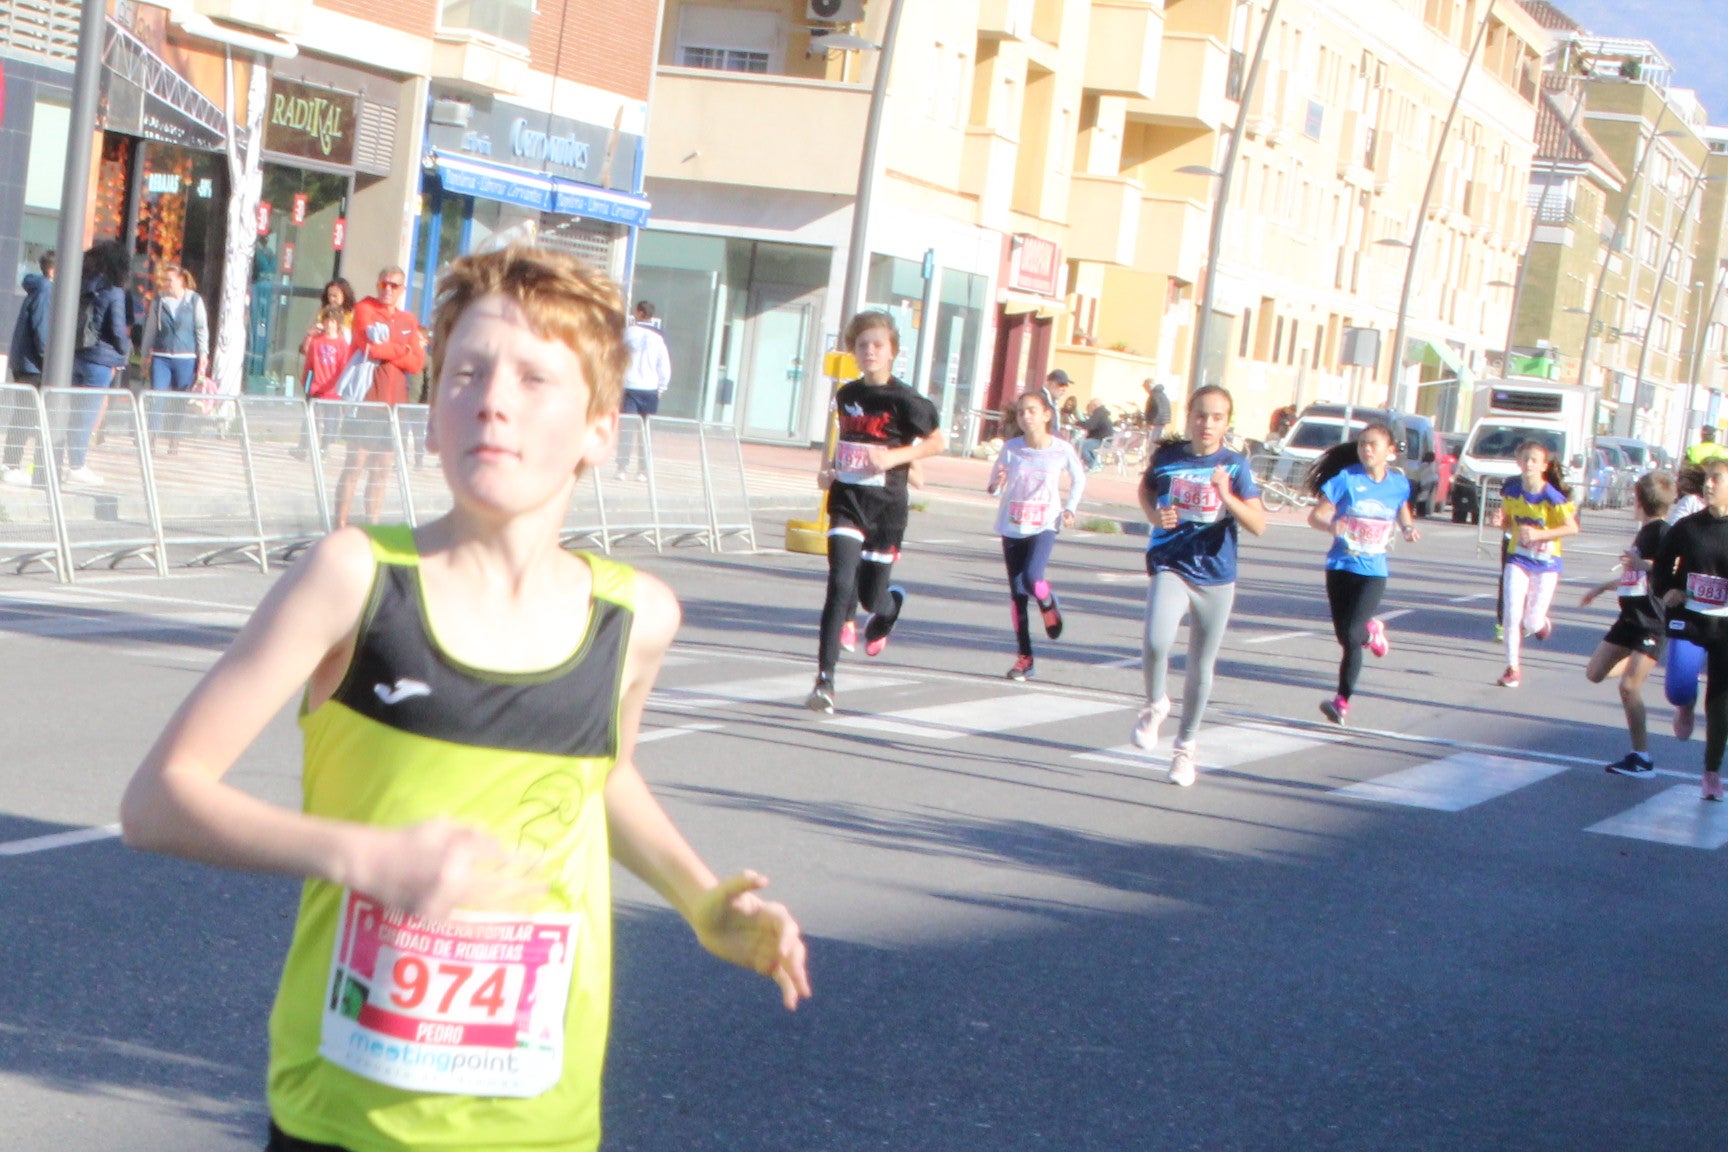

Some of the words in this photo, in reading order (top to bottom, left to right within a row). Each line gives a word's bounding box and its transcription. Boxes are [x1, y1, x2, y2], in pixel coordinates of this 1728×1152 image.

[272, 93, 342, 155] RADIKAL
[1184, 491, 1210, 505] 961
[378, 923, 431, 953] CIUDAD
[433, 938, 452, 958] DE
[454, 940, 524, 962] ROQUETAS
[407, 912, 473, 939] CARRERA
[474, 920, 534, 943] POPULAR
[390, 955, 507, 1018] 974
[416, 1022, 465, 1046] PEDRO
